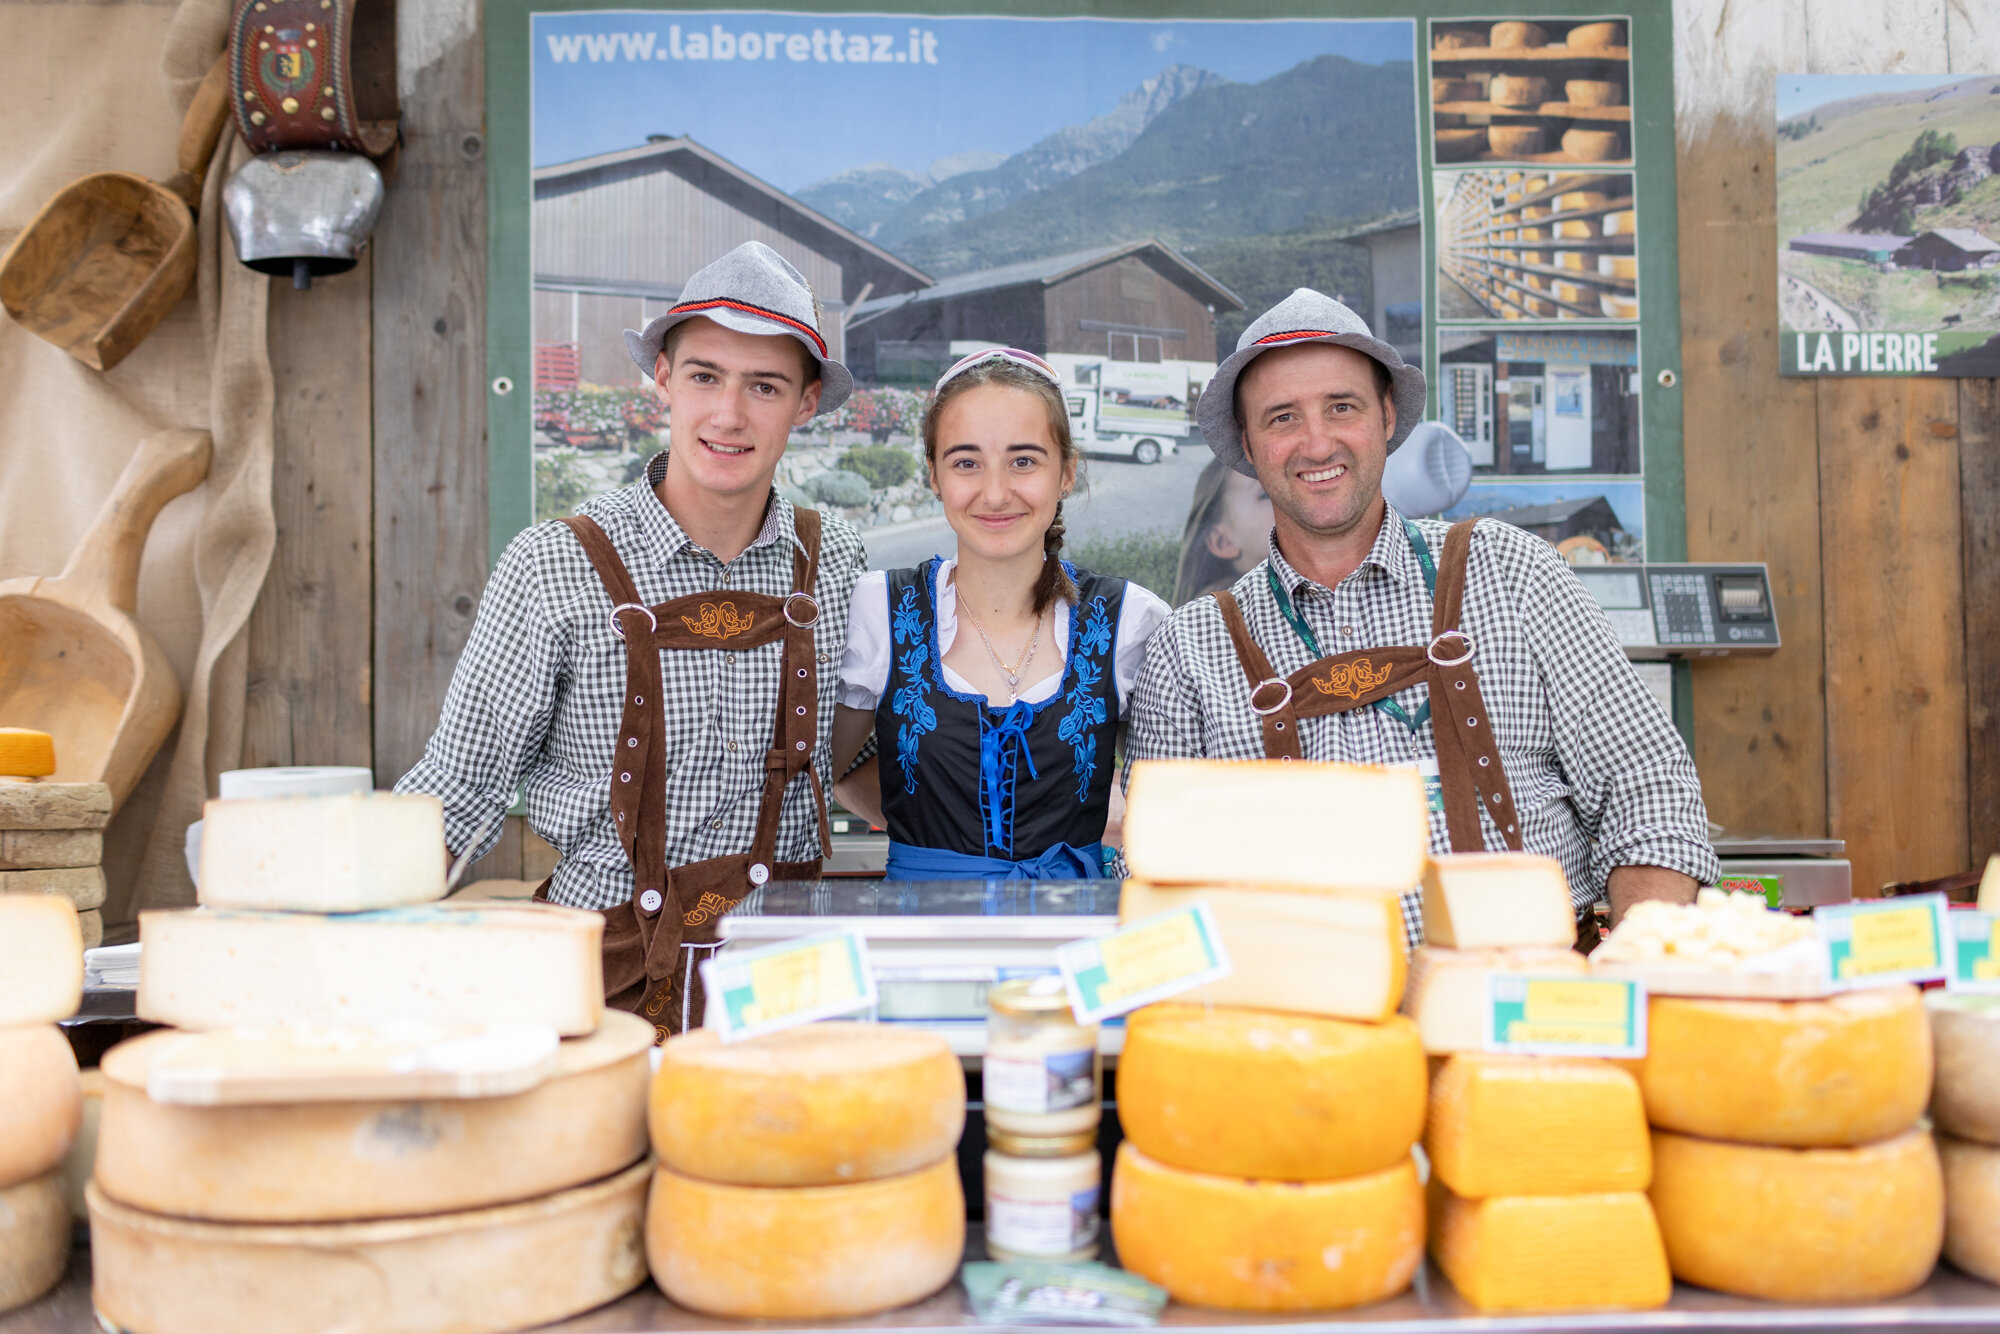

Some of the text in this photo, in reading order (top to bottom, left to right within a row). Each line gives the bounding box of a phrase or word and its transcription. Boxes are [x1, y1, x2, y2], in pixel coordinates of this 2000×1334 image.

[546, 24, 939, 65] www.laborettaz.it
[1502, 335, 1580, 350] VENDITA
[1797, 333, 1939, 372] LA PIERRE
